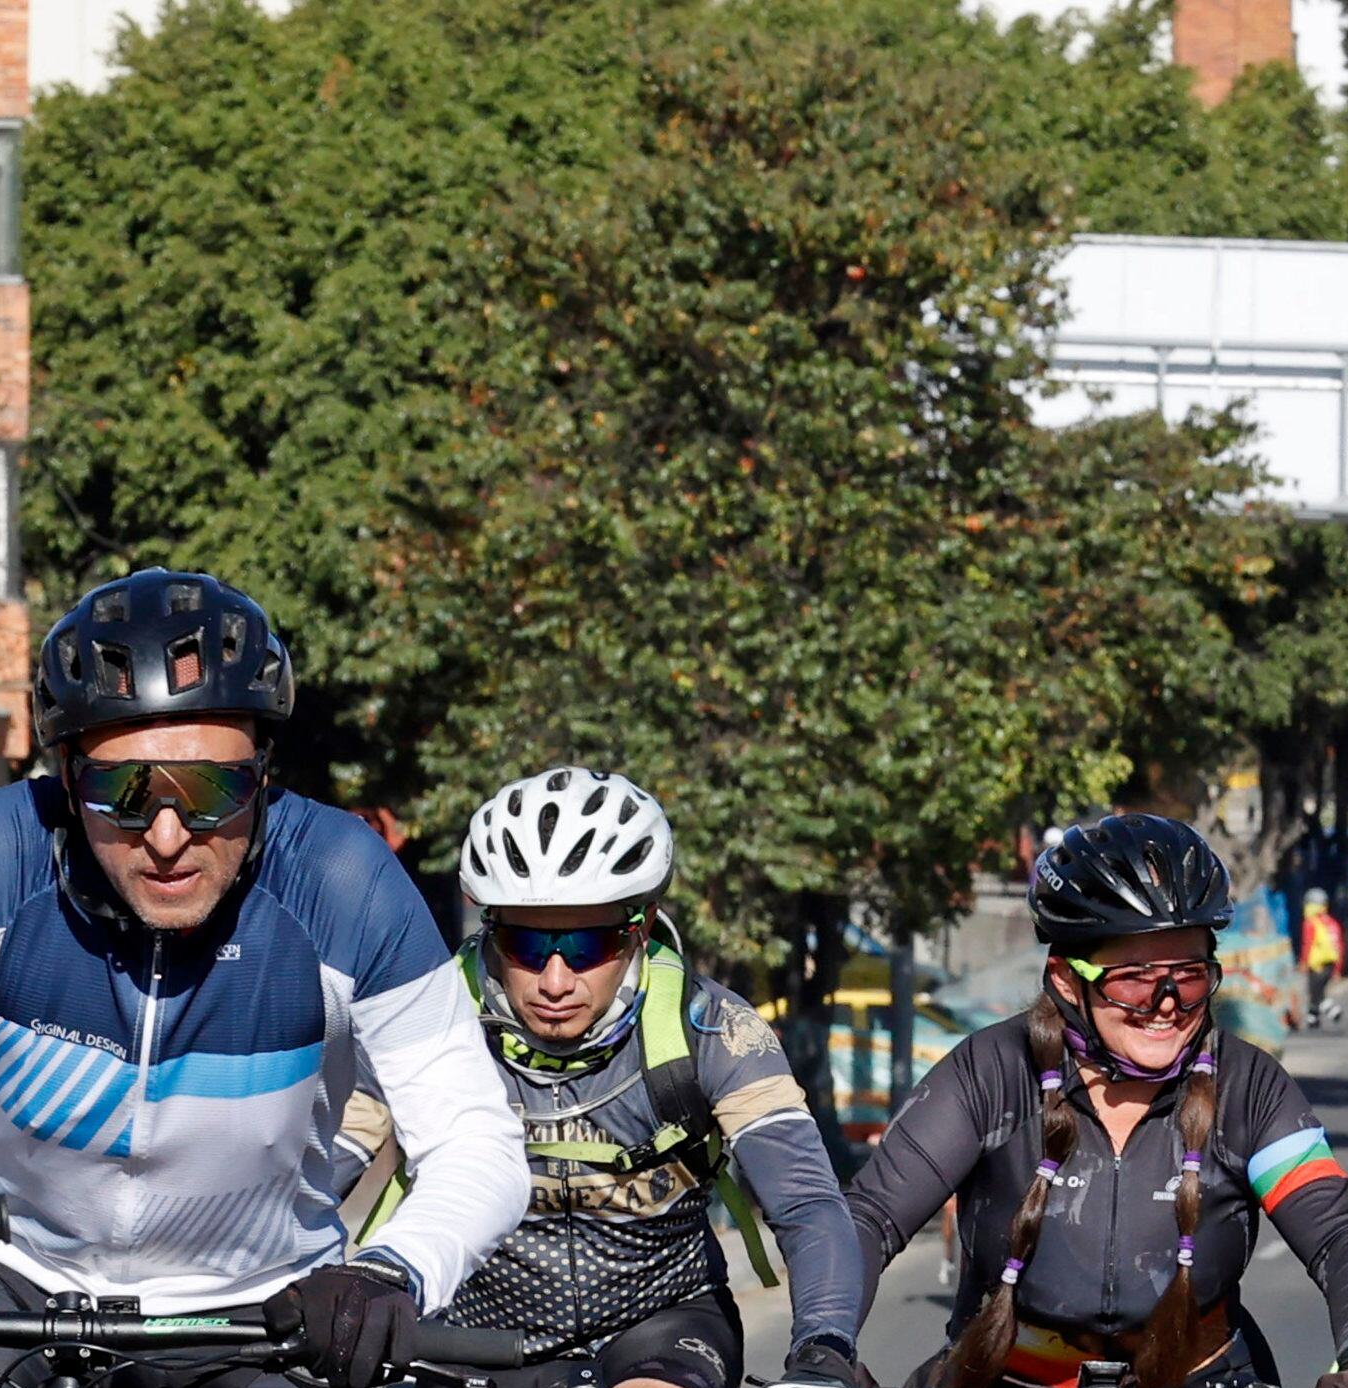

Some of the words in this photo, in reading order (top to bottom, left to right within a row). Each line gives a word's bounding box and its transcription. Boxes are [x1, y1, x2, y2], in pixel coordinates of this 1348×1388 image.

[85, 1033, 128, 1060] DESIGN
[529, 1182, 646, 1213] RVEZA
[142, 1316, 232, 1328] HAMMER
